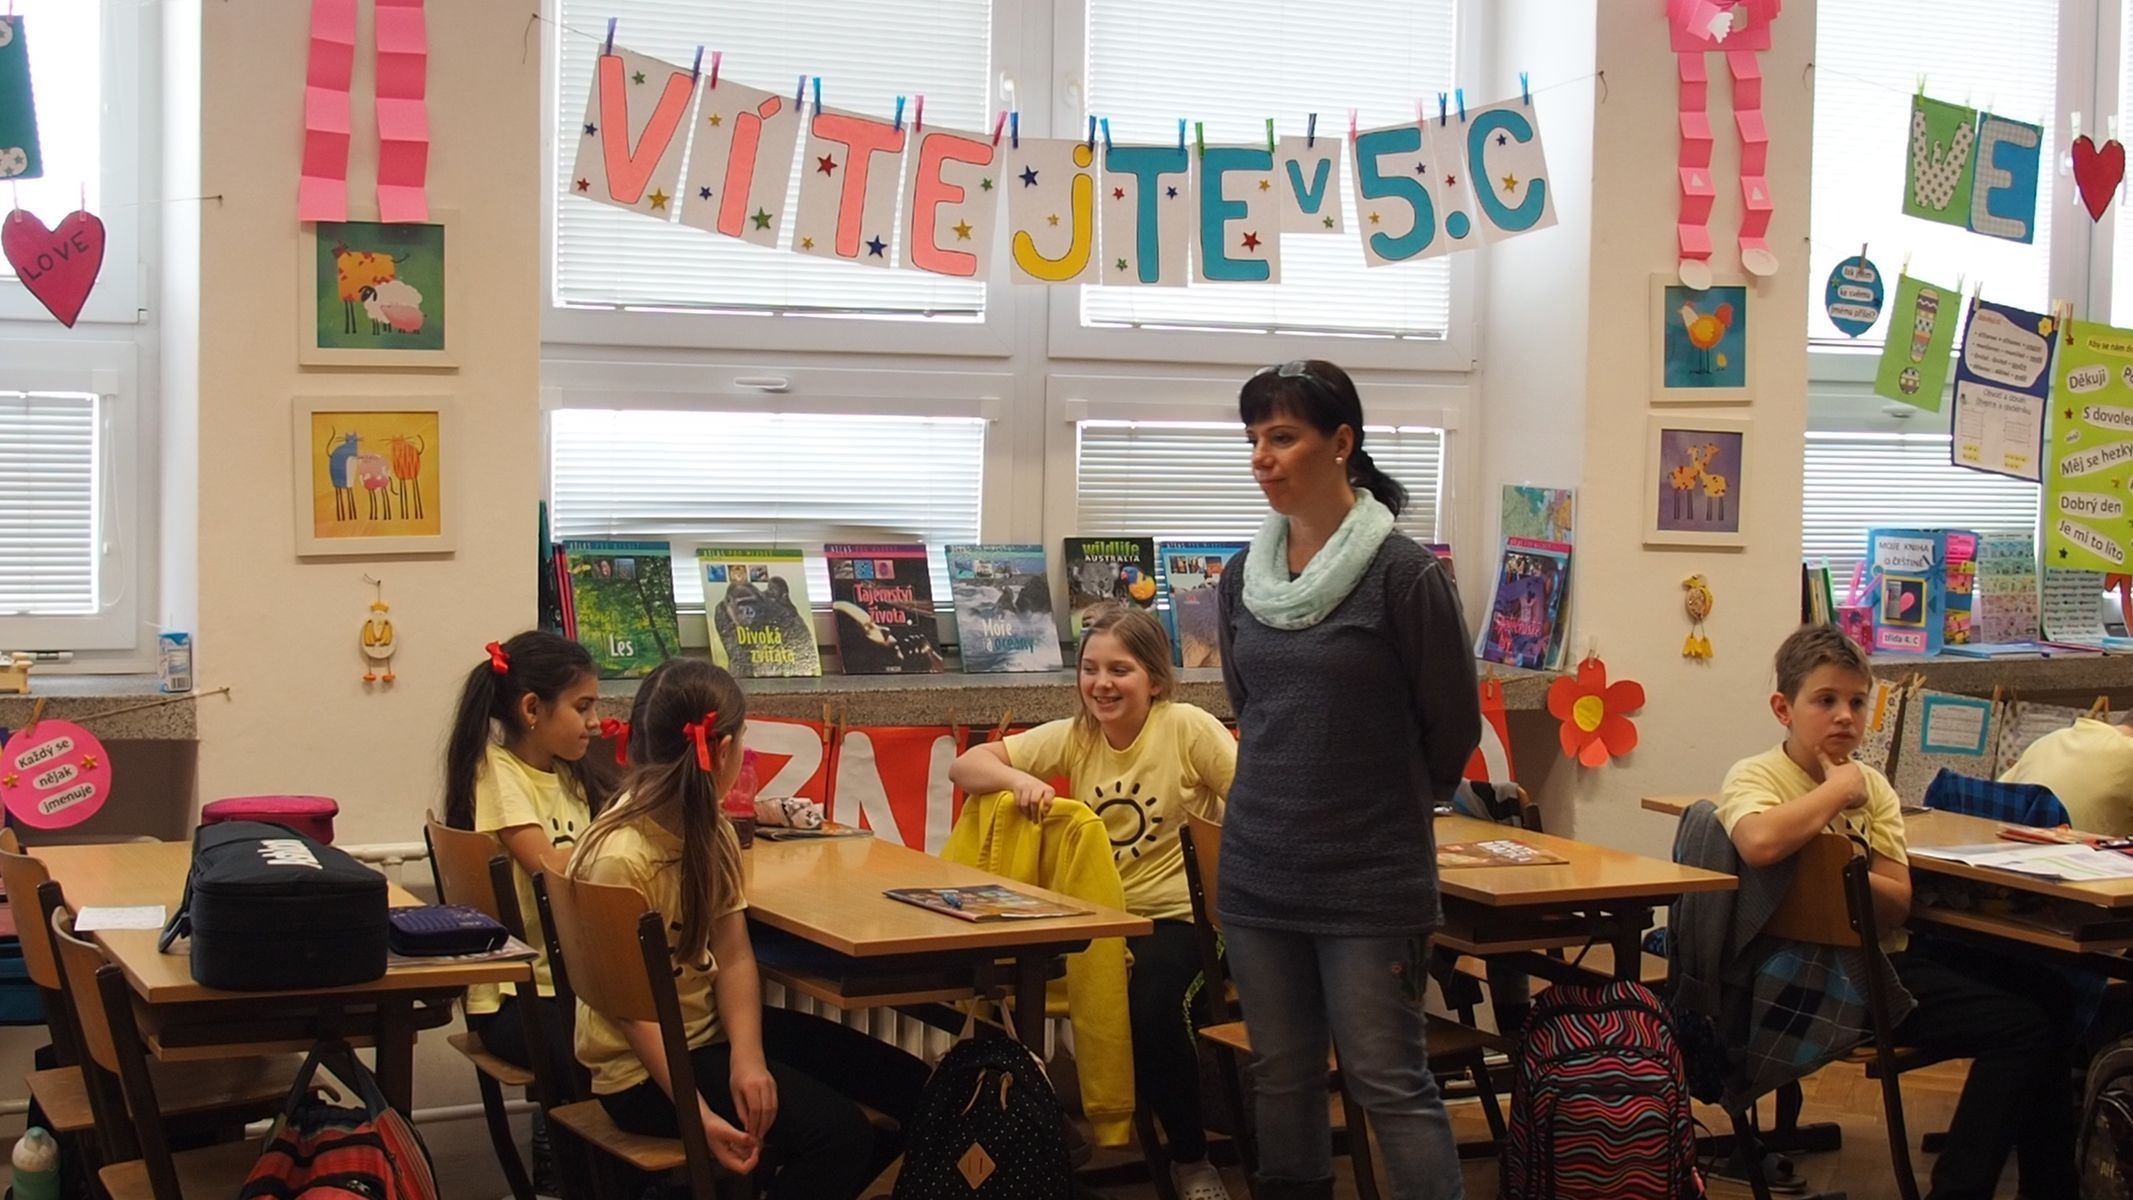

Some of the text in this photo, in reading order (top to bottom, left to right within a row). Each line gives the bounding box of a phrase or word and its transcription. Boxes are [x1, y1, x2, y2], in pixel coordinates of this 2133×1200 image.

[22, 230, 90, 281] LOVE
[2069, 369, 2106, 389] Děkuji
[2083, 406, 2090, 419] S
[2061, 455, 2084, 475] Měj
[2088, 455, 2099, 468] se
[2061, 496, 2121, 514] Dobrý den
[1082, 541, 1140, 556] wildlife
[1879, 542, 1930, 553] MOJE KNIHA
[2059, 520, 2124, 561] Je mi to líto
[856, 584, 913, 604] Tajemství
[870, 607, 907, 625] života
[736, 626, 782, 645] Divoká
[983, 619, 1012, 637] Moře
[610, 635, 634, 657] Les
[986, 636, 1034, 653] a oceány
[1885, 633, 1902, 643] třída
[750, 645, 795, 664] zvířata
[18, 740, 70, 769] Každý se
[39, 766, 73, 787] nějak
[43, 784, 93, 812] jmenuje
